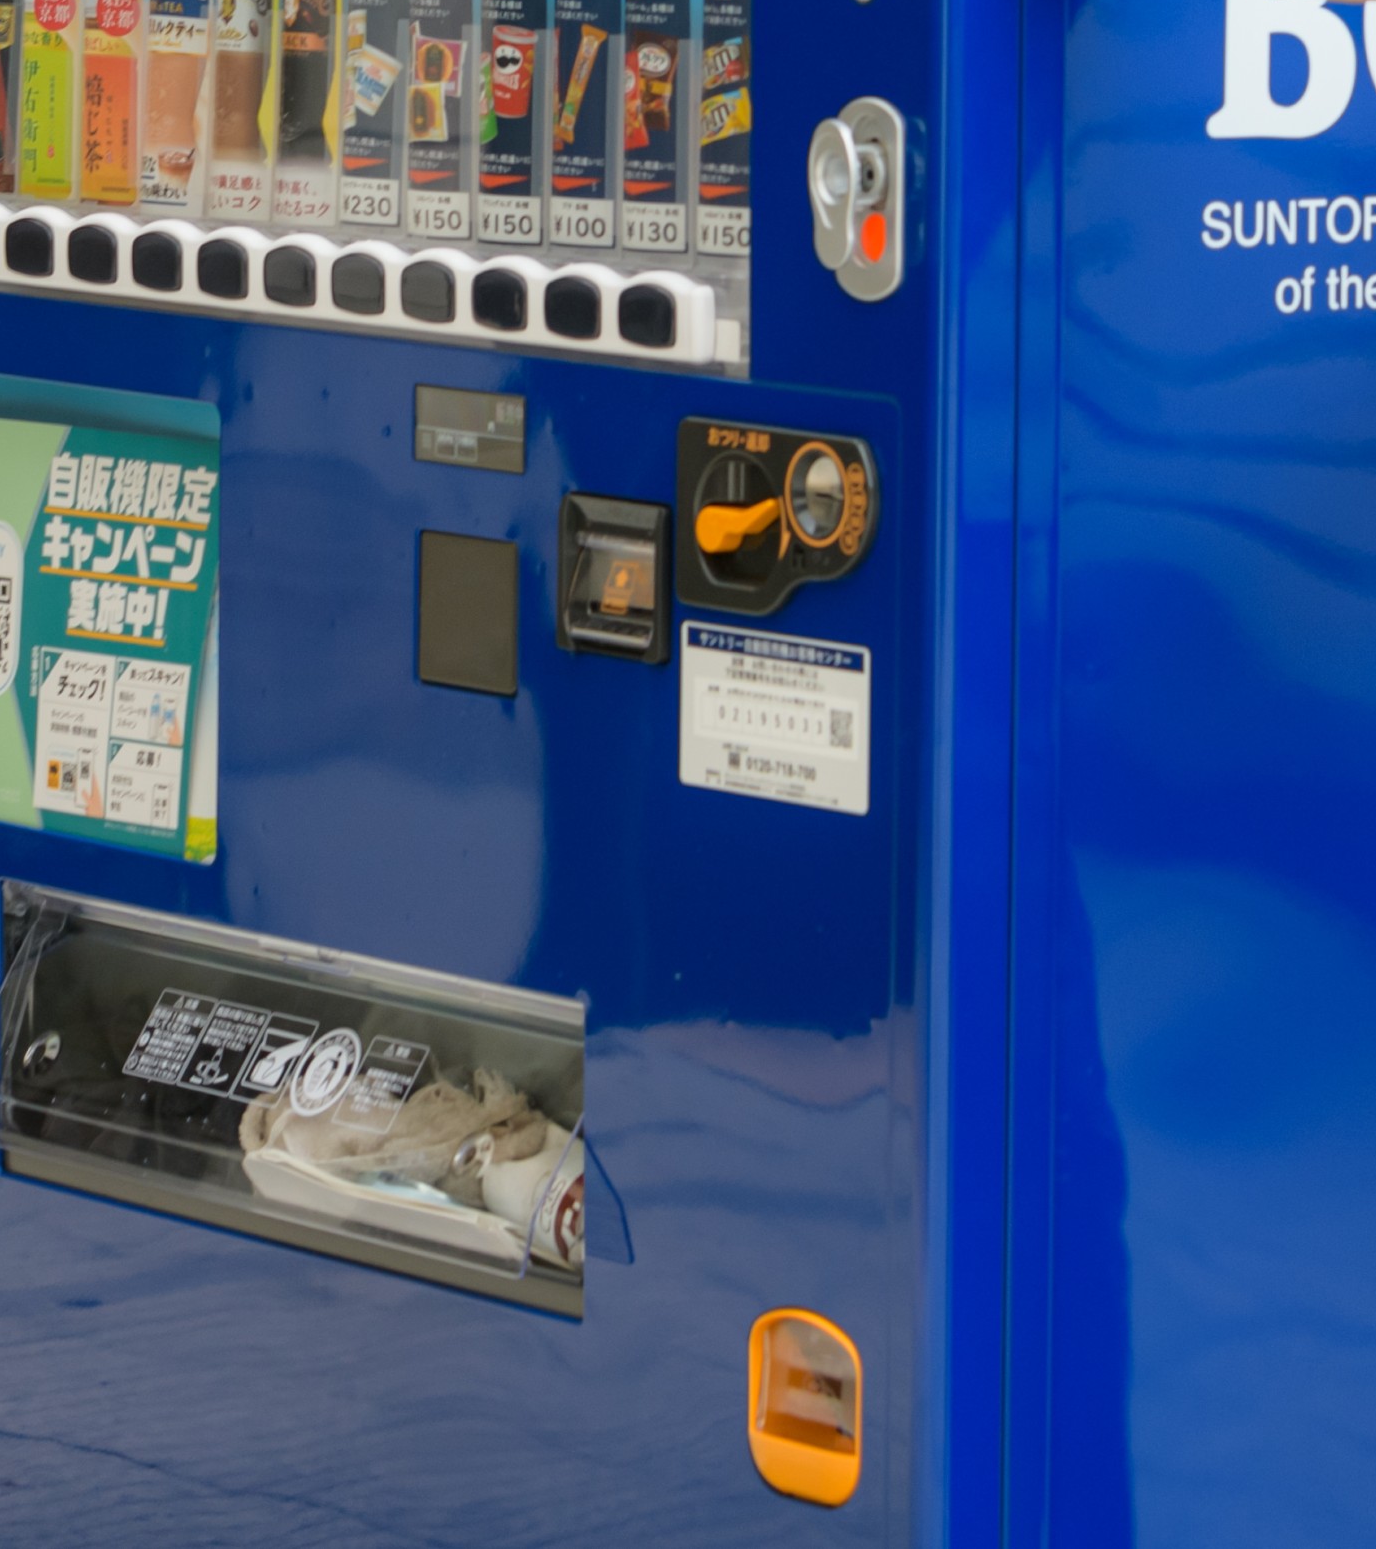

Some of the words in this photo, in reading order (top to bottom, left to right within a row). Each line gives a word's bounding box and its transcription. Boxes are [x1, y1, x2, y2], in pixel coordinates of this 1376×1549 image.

[38, 3, 72, 24] 京都
[101, 9, 136, 29] 京都
[342, 195, 392, 218] ¥230
[412, 209, 463, 231] ¥150
[482, 213, 534, 236] ¥150
[553, 215, 607, 239] ¥100
[626, 221, 678, 244] ¥130
[1274, 265, 1315, 314] of
[44, 452, 219, 526] 自販機限定
[40, 515, 206, 584] キャンペーン
[68, 579, 169, 641] 実施中!
[57, 674, 107, 702] チェック!
